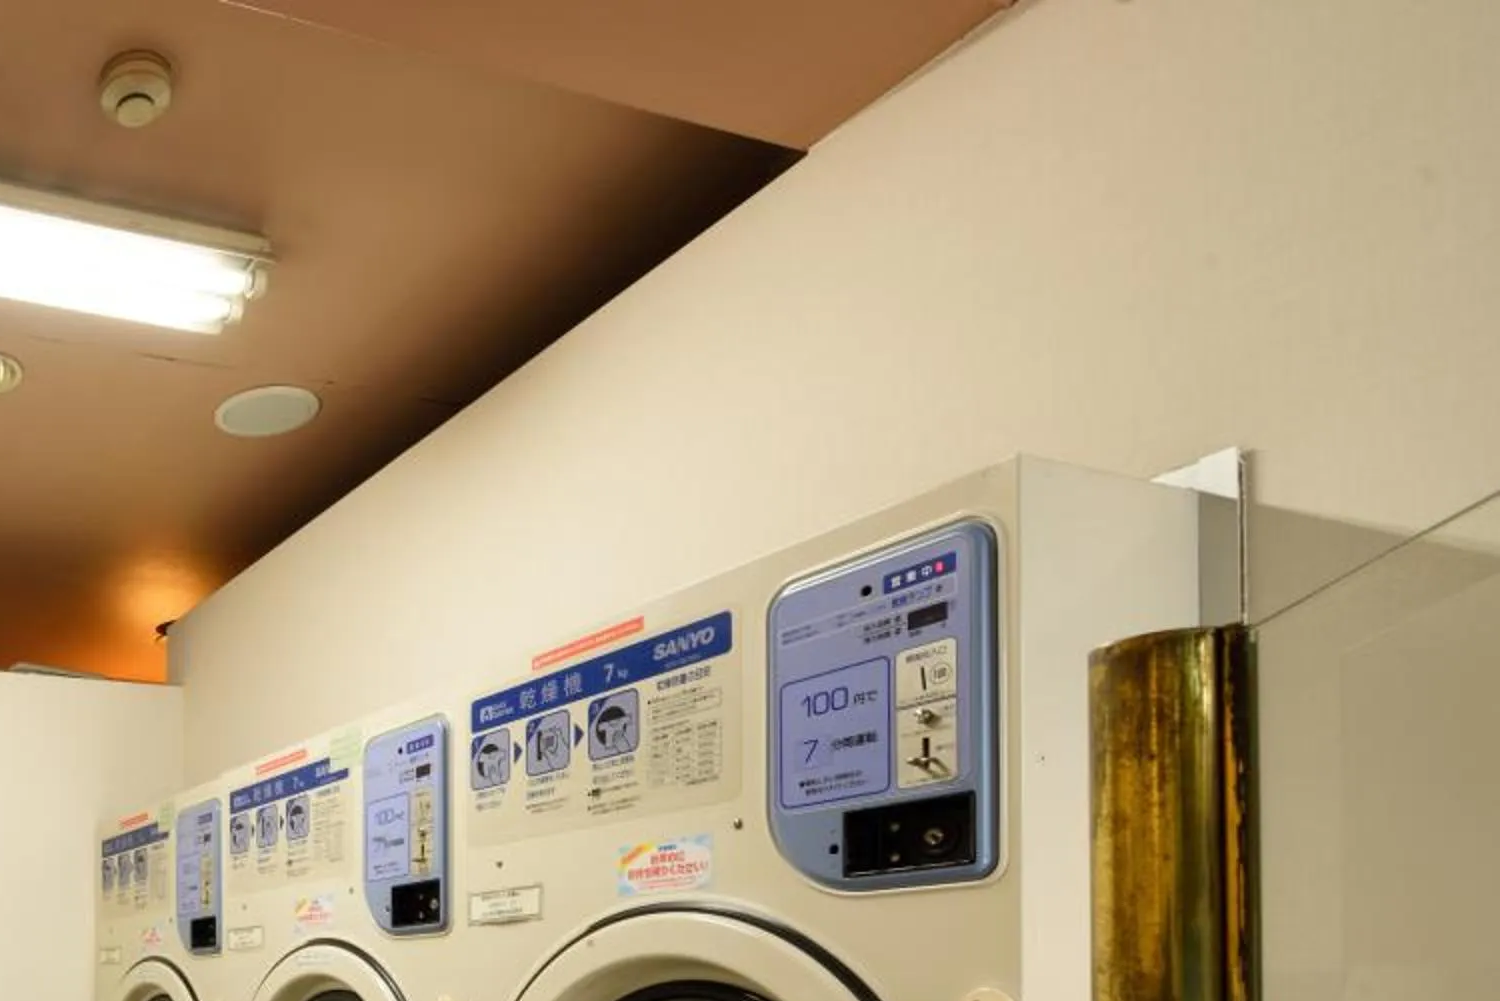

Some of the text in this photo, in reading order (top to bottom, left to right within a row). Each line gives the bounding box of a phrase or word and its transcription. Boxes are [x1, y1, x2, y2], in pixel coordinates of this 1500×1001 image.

[652, 626, 715, 661] SANYO
[602, 664, 614, 683] 7
[801, 686, 849, 718] 100
[803, 737, 820, 764] 7
